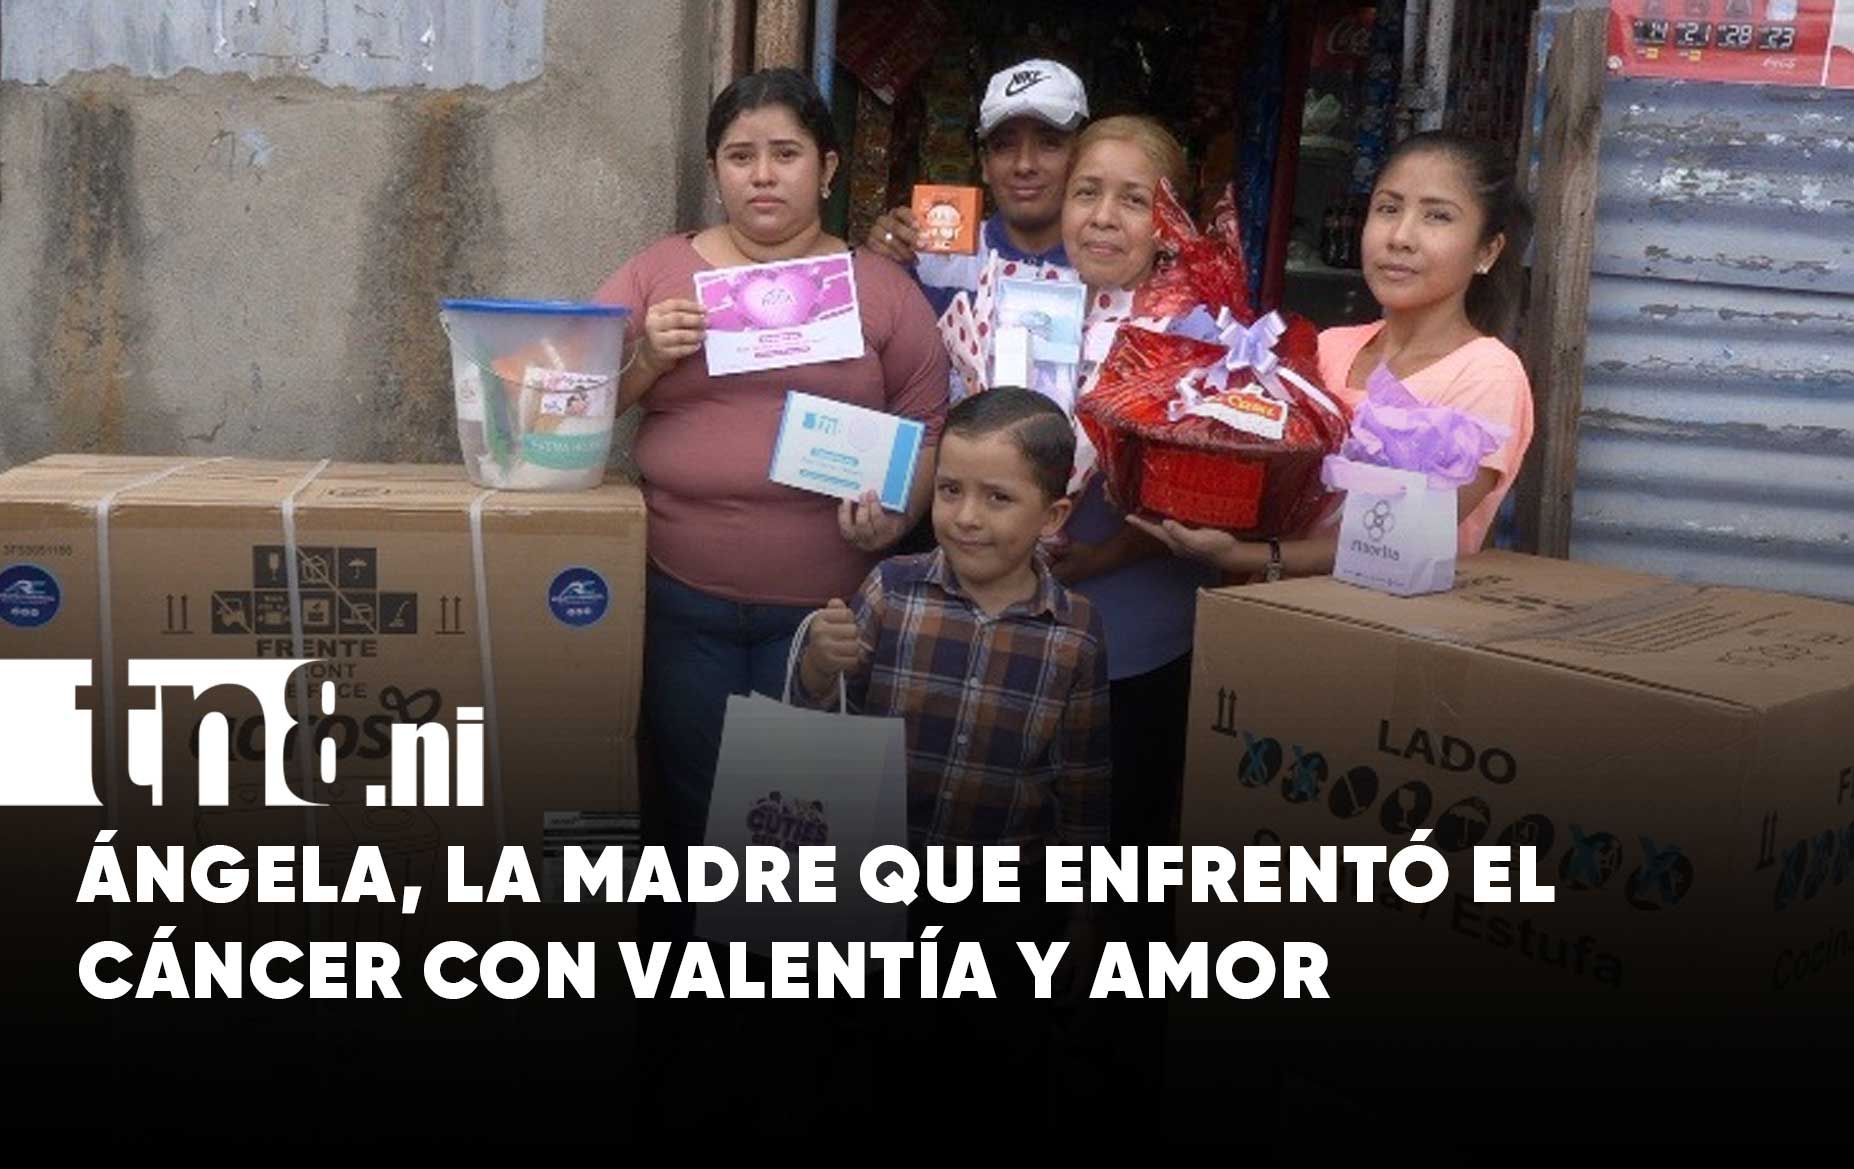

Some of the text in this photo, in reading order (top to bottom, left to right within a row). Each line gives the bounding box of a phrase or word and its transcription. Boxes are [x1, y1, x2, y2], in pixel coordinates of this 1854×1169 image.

[1684, 22, 1711, 42] 21
[1726, 25, 1752, 44] 28
[1768, 26, 1795, 48] 23
[257, 639, 377, 657] FRENTE
[307, 682, 367, 699] FCE
[1378, 719, 1517, 785] LADO
[748, 807, 829, 848] CUTIES
[1453, 893, 1623, 989] Estufa
